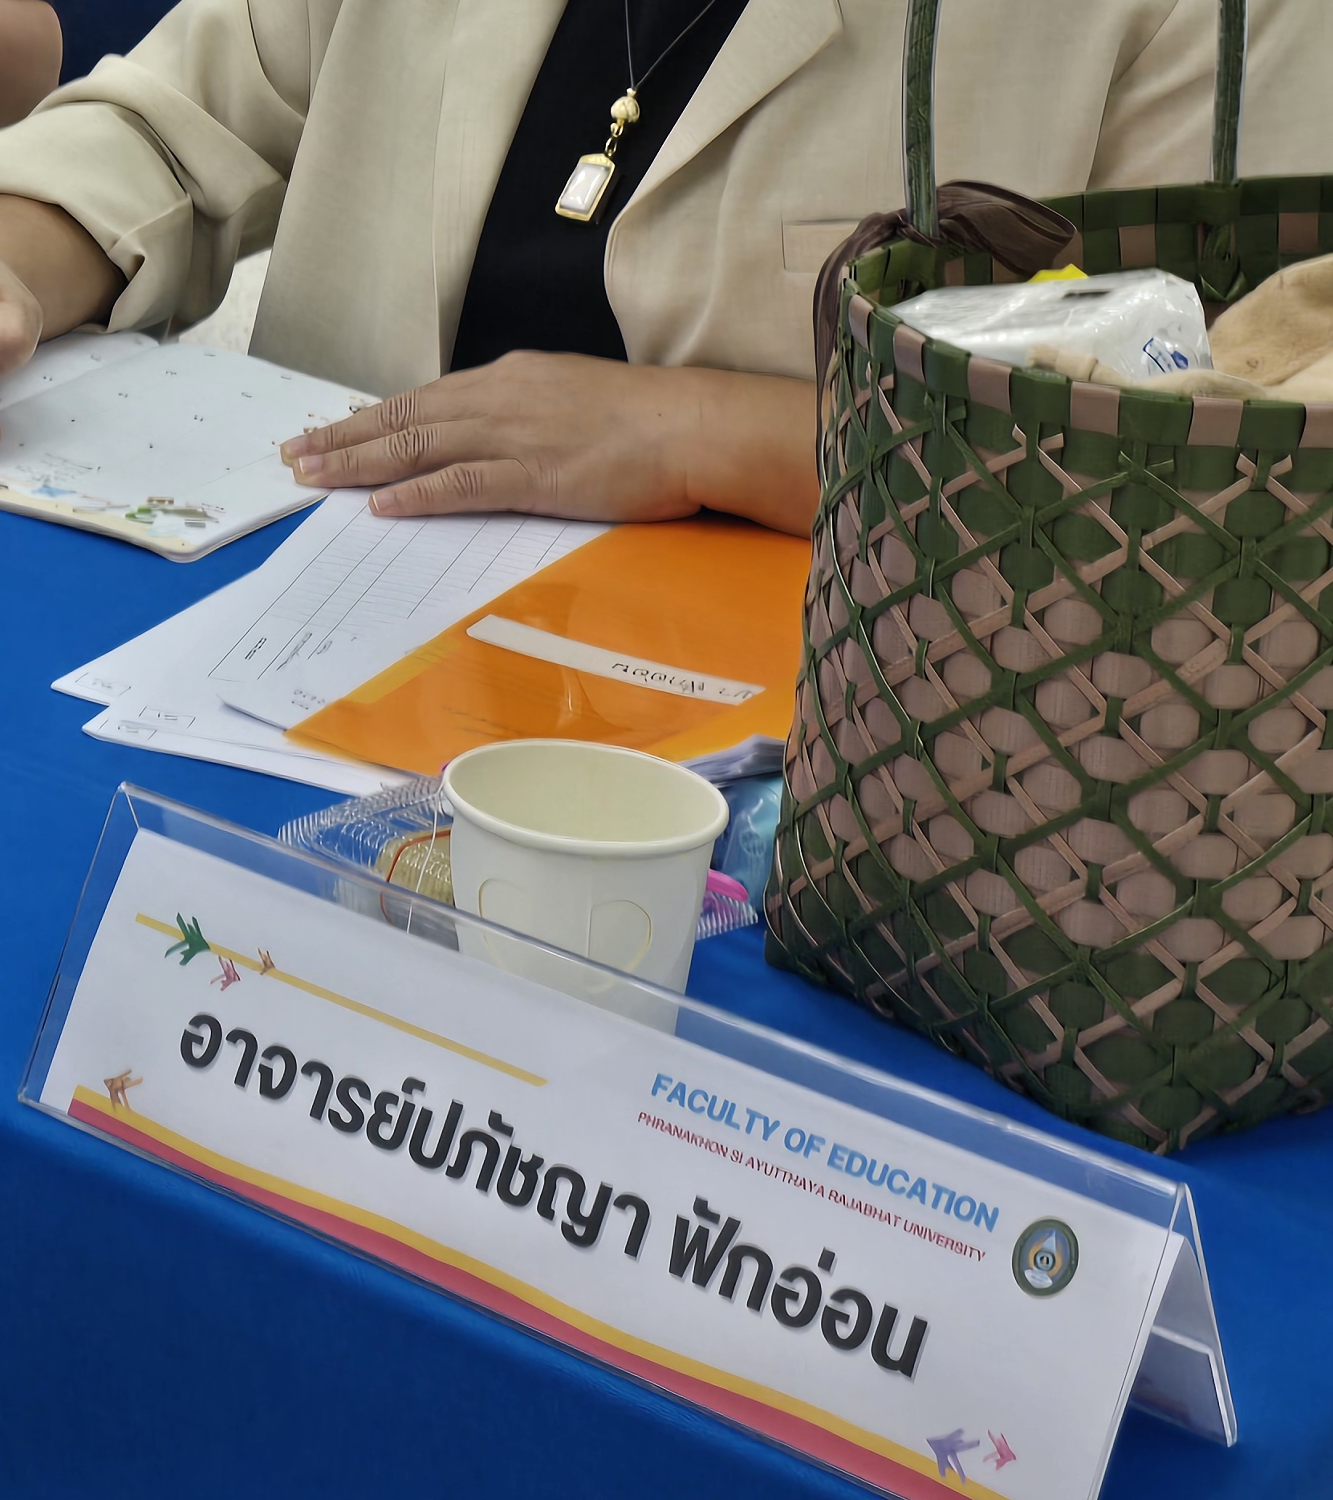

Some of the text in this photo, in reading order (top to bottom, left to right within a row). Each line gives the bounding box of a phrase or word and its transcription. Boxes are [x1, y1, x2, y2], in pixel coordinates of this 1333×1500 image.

[179, 1011, 929, 1379] อาจารย์ปภัชญา ฟักอ่อน
[637, 1111, 986, 1262] PHRANAKHON SI AYUTTHAYA RAJABHAT UNIVERSITY
[651, 1073, 1000, 1233] FACULTY OF EDUCATION
